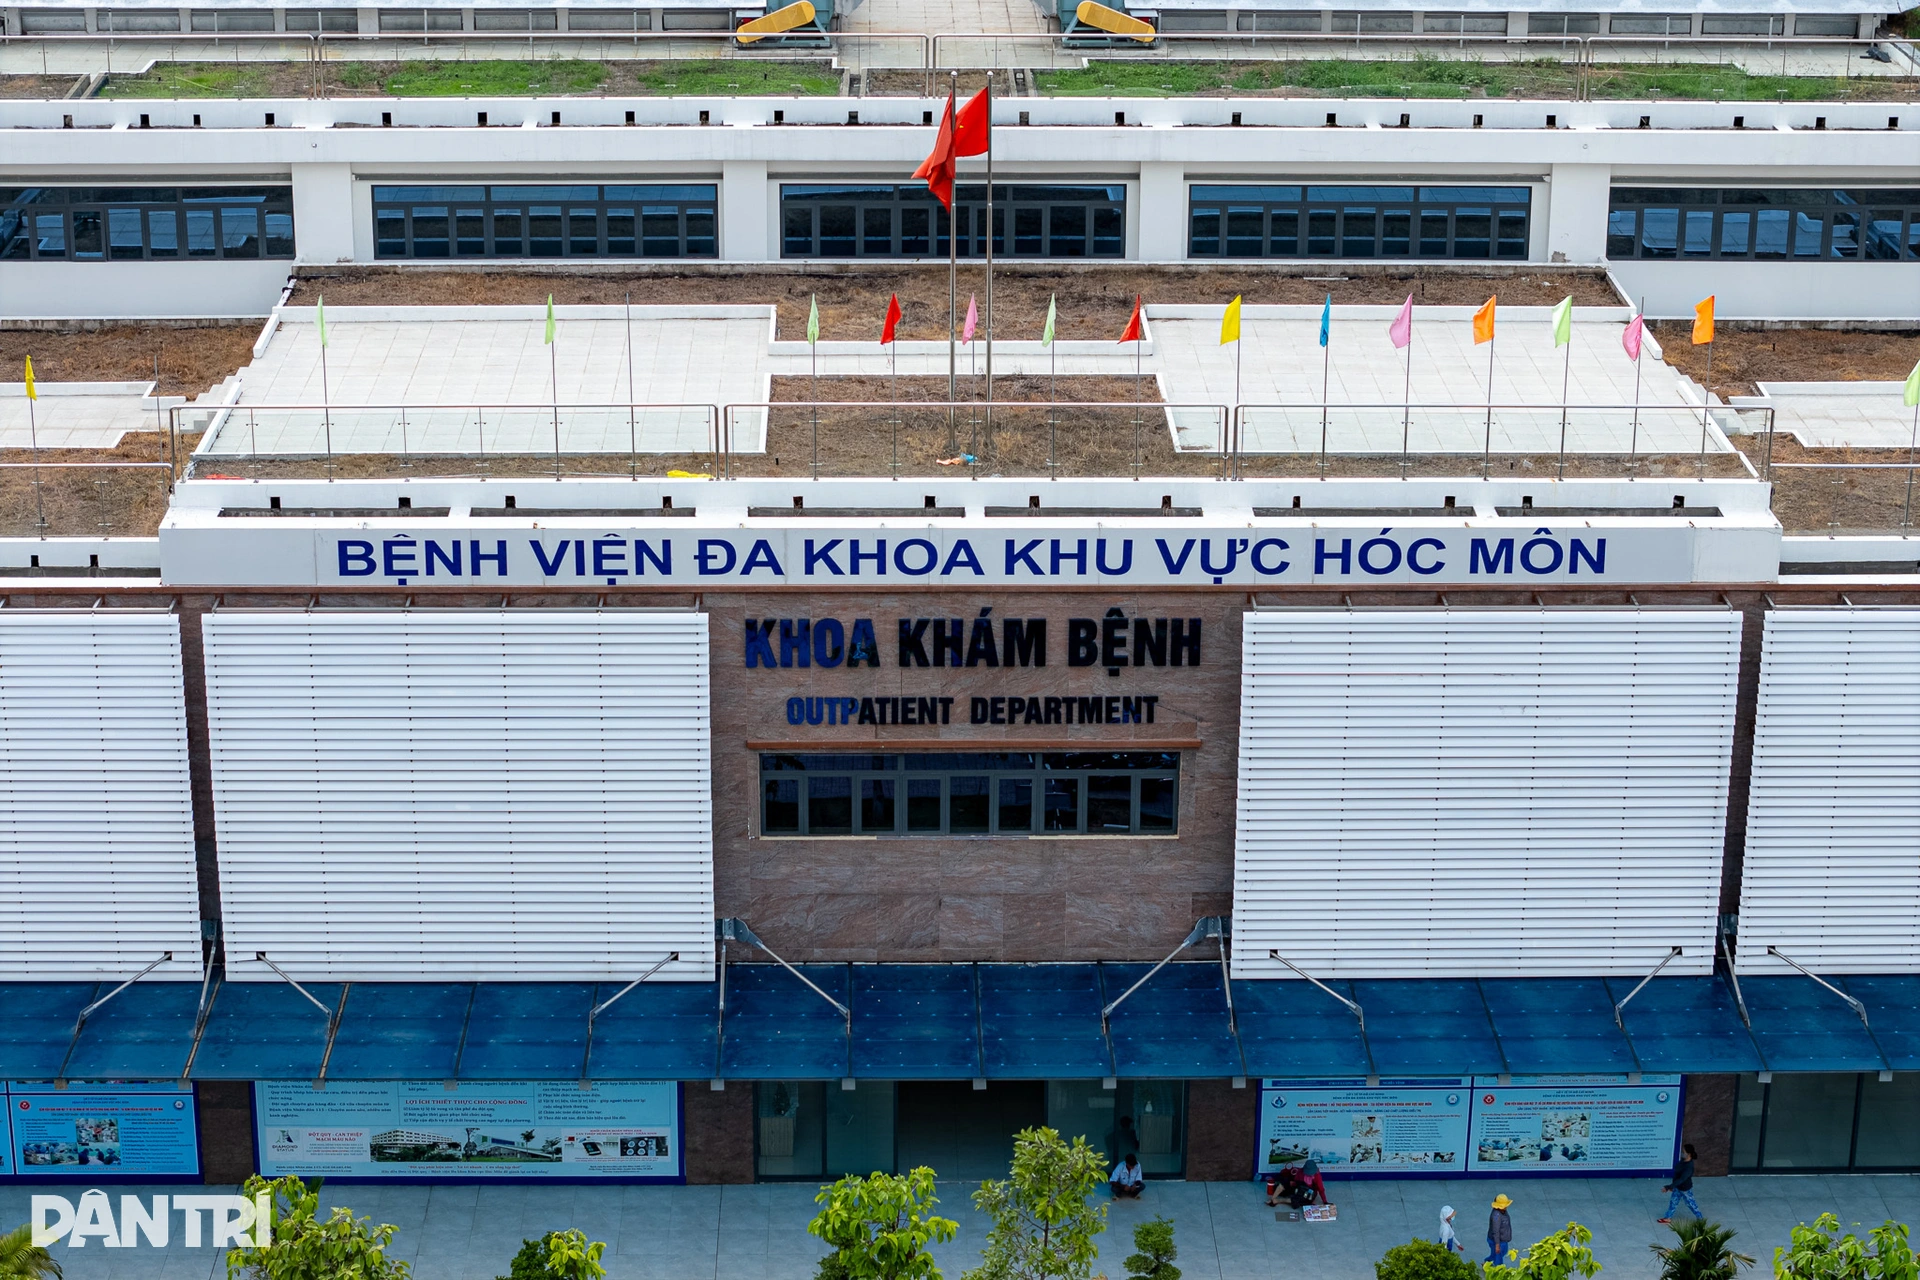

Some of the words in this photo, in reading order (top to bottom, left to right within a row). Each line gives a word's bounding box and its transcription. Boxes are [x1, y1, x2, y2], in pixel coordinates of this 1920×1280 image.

[338, 534, 507, 585] BỆNH
[530, 533, 672, 585] VIỆN
[694, 539, 785, 575] ĐA
[805, 539, 984, 575] KHOA
[1005, 539, 1133, 575] KHU
[1155, 538, 1290, 585] VỰC
[1314, 528, 1445, 575] HÓC
[1470, 528, 1606, 574] MÔN
[744, 618, 880, 668] KHOA
[897, 607, 1047, 667] KHÁM
[1068, 607, 1202, 677] BỆNH
[786, 696, 955, 726] OUTPATIENT
[970, 695, 1159, 725] DEPARTMENT
